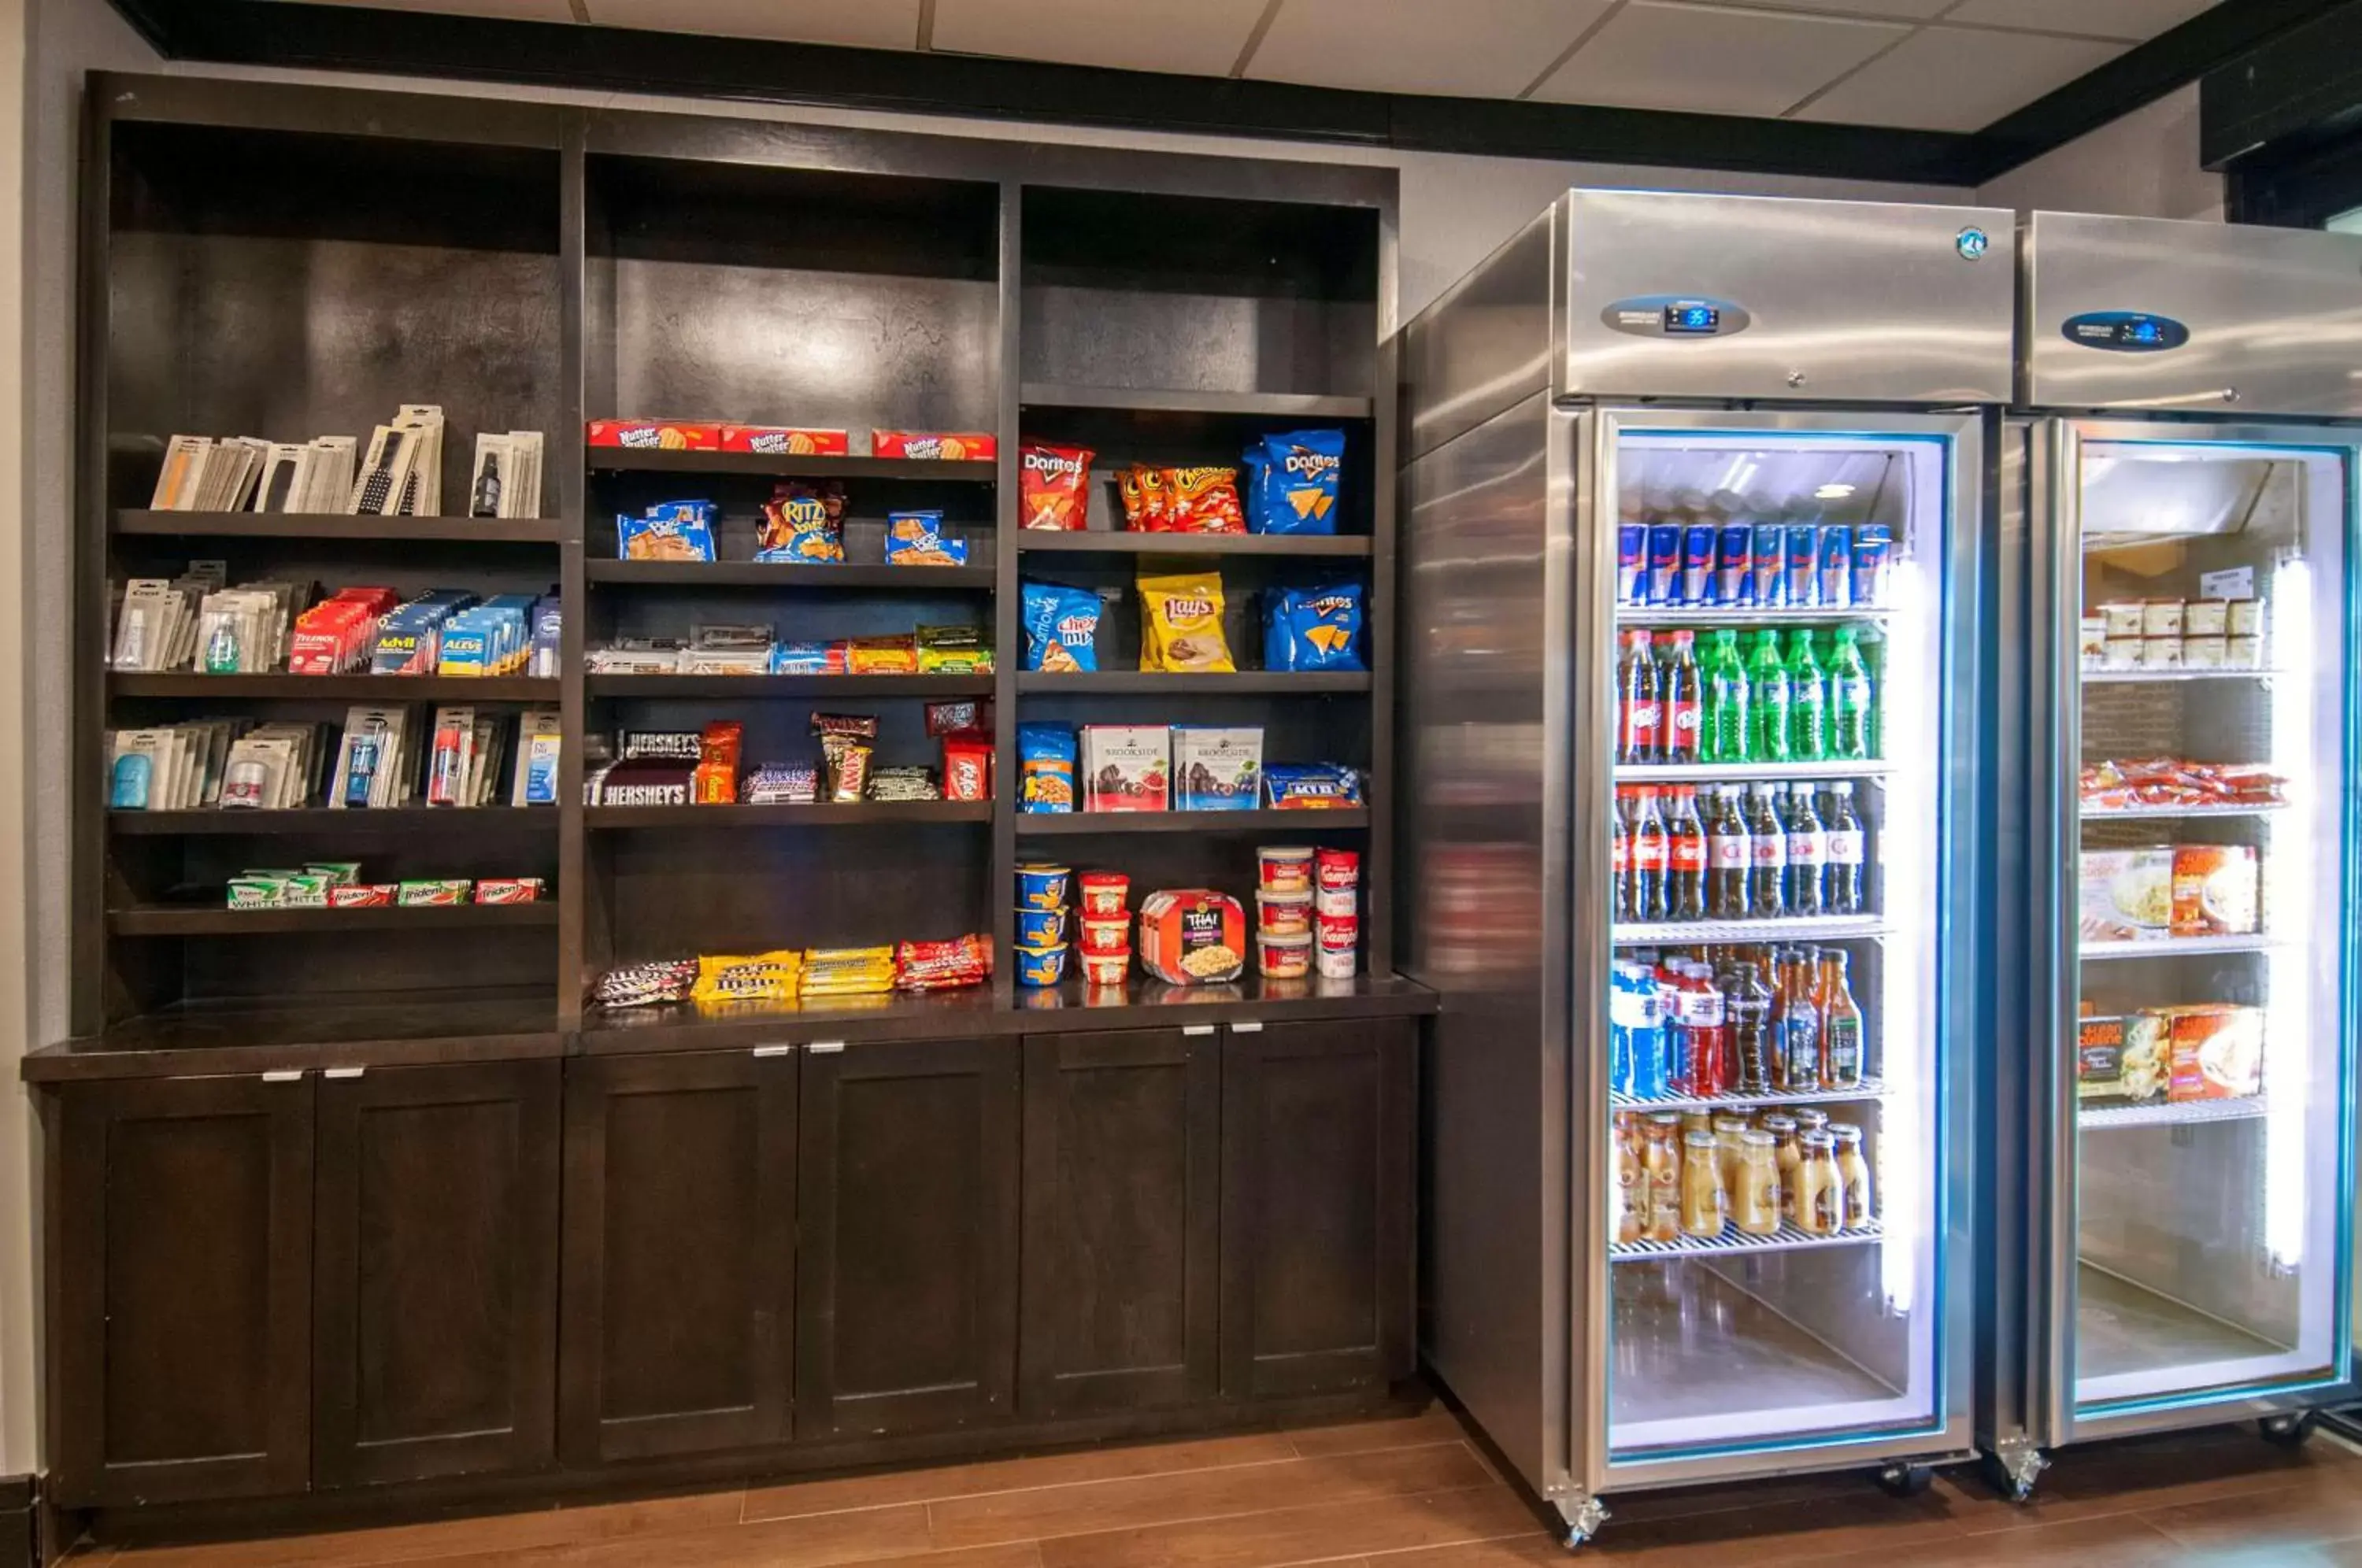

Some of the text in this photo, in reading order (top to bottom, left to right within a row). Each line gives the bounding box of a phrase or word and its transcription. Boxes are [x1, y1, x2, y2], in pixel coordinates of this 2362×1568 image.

[618, 428, 655, 444] Nutter
[749, 434, 785, 449] Nutter
[903, 439, 937, 455] Nutter
[1024, 453, 1083, 474] Doritos
[784, 501, 824, 524] RITZ
[378, 637, 416, 649] Advil
[631, 732, 700, 753] HERSHEY'S
[1105, 748, 1159, 756] BROOKSIDE
[605, 784, 685, 805] HERSHEY'S
[335, 889, 376, 901] Trident
[405, 887, 442, 900] Trident
[482, 884, 521, 898] Trident
[232, 899, 281, 908] WHITE
[1187, 914, 1218, 926] THAI
